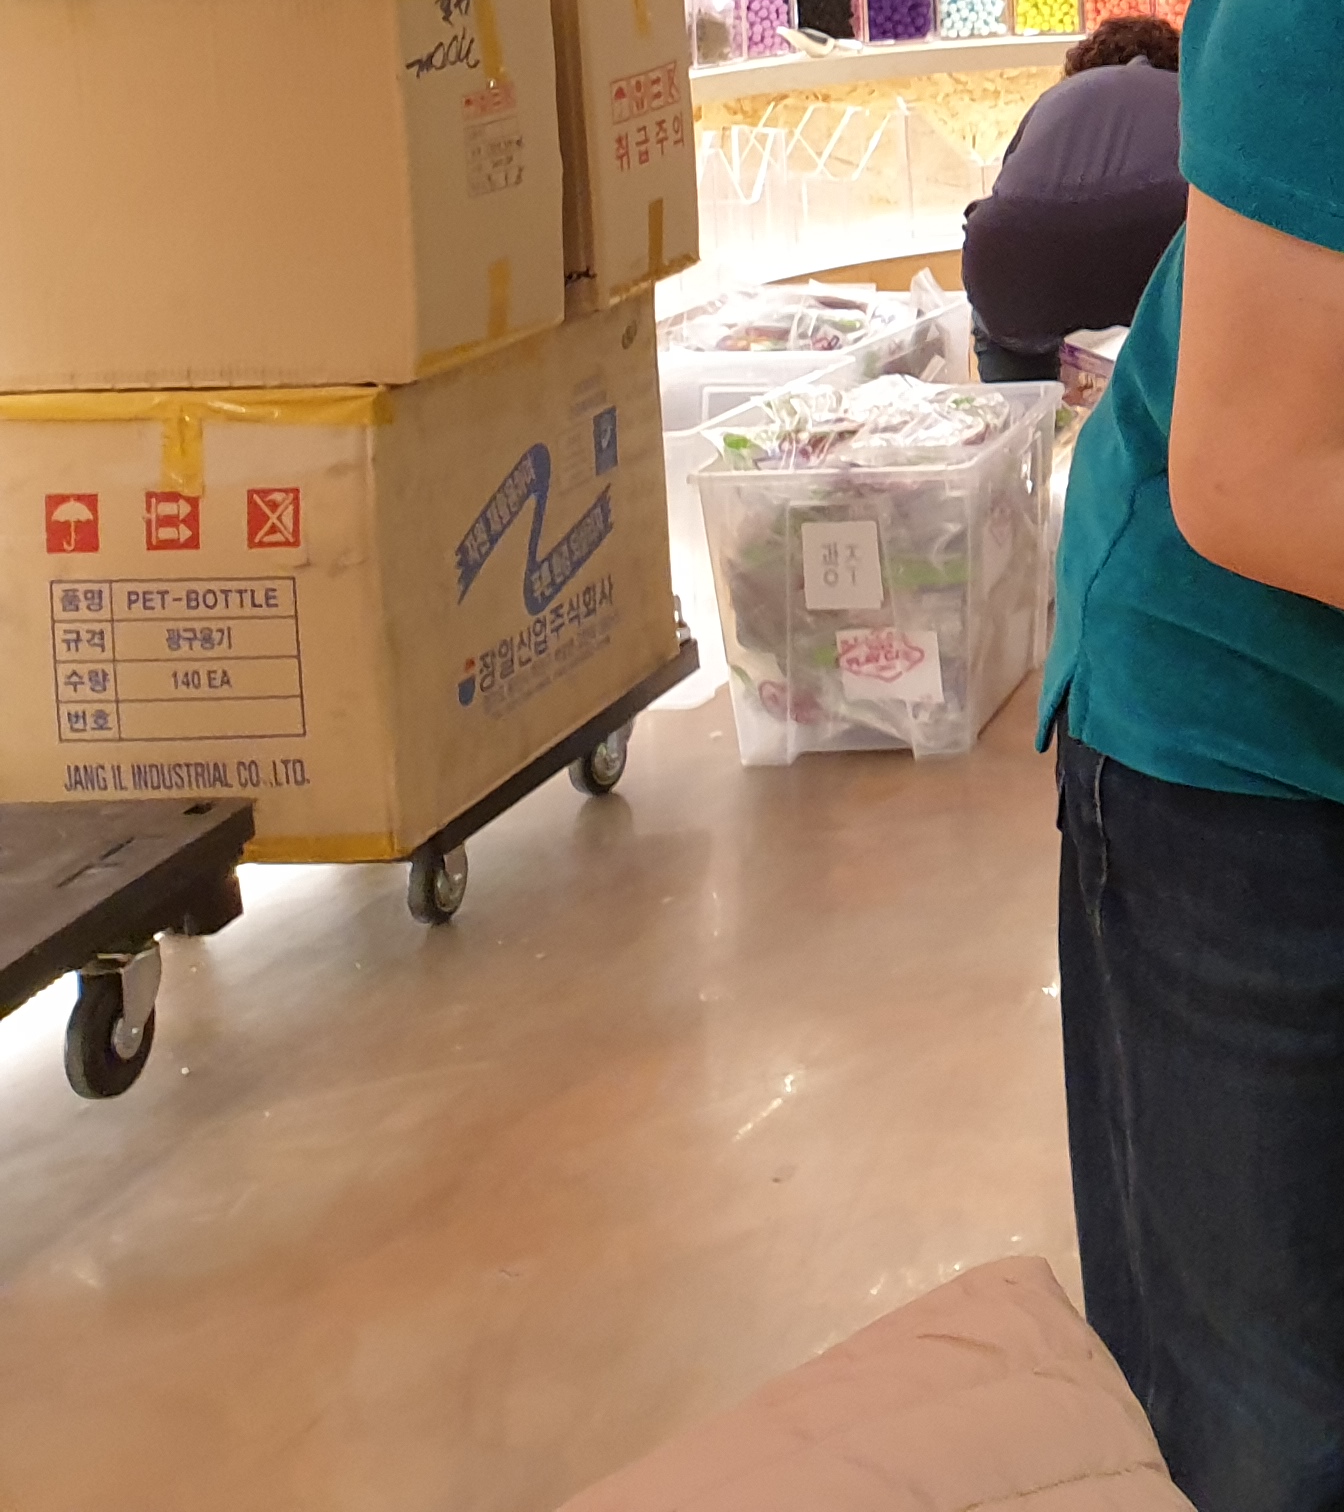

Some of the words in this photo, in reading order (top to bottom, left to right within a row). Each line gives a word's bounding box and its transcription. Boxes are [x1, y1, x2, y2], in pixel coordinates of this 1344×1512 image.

[614, 111, 686, 172] 취급주의
[60, 587, 104, 613] 품명
[126, 587, 279, 610] PET-BOTTLE
[62, 628, 106, 653] 규격
[64, 668, 110, 694] 수량
[171, 669, 201, 690] 140
[206, 669, 233, 689] EA
[67, 708, 113, 733] 번호
[64, 763, 108, 792] JANG
[111, 763, 129, 792] IL
[130, 760, 234, 791] INDUSTRIAL
